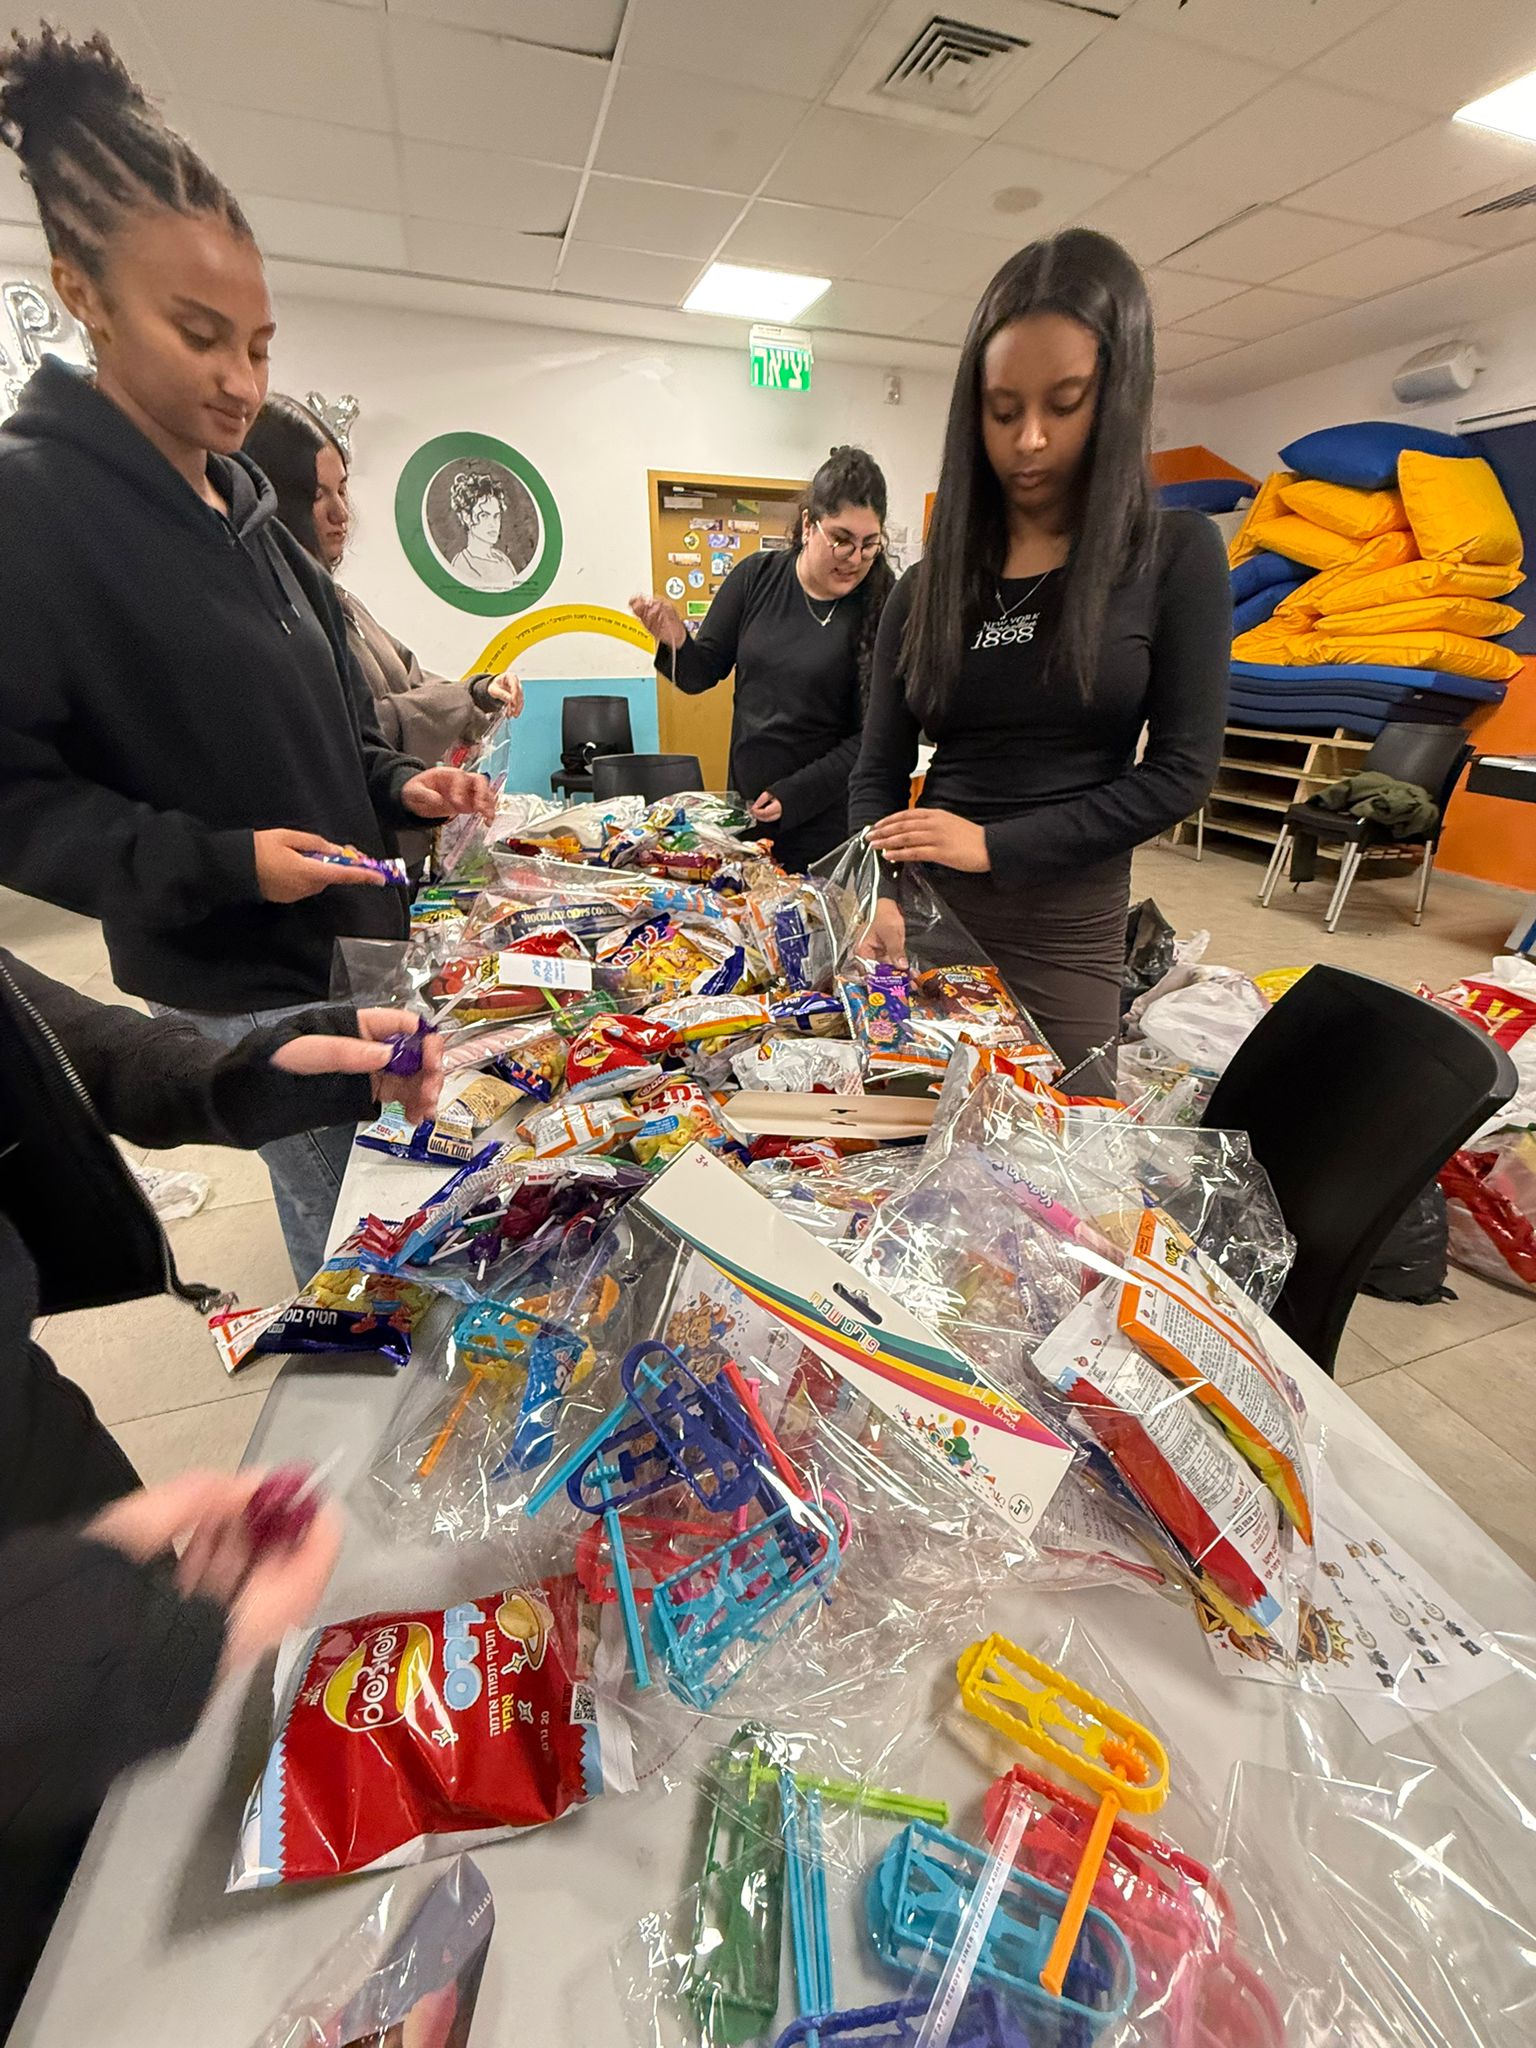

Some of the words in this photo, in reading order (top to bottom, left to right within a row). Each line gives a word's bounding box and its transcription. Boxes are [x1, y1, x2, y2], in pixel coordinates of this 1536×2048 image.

[753, 347, 810, 389] יציאה
[1010, 612, 1040, 623] YORK
[970, 626, 1034, 650] 1898
[695, 1154, 709, 1168] 3+
[306, 1311, 339, 1328] חטיף
[485, 1629, 499, 1662] חטיף
[487, 1662, 499, 1697] תפוח
[488, 1698, 501, 1738] אדמה
[501, 1693, 515, 1733] אפוי
[540, 1710, 550, 1725] 20
[540, 1729, 549, 1751] גרם
[933, 2006, 949, 2035] TAPE
[945, 1965, 963, 2005] REMOVE
[960, 1936, 974, 1965] LINER
[972, 1921, 979, 1935] TO
[977, 1885, 994, 1921] EXPOSE
